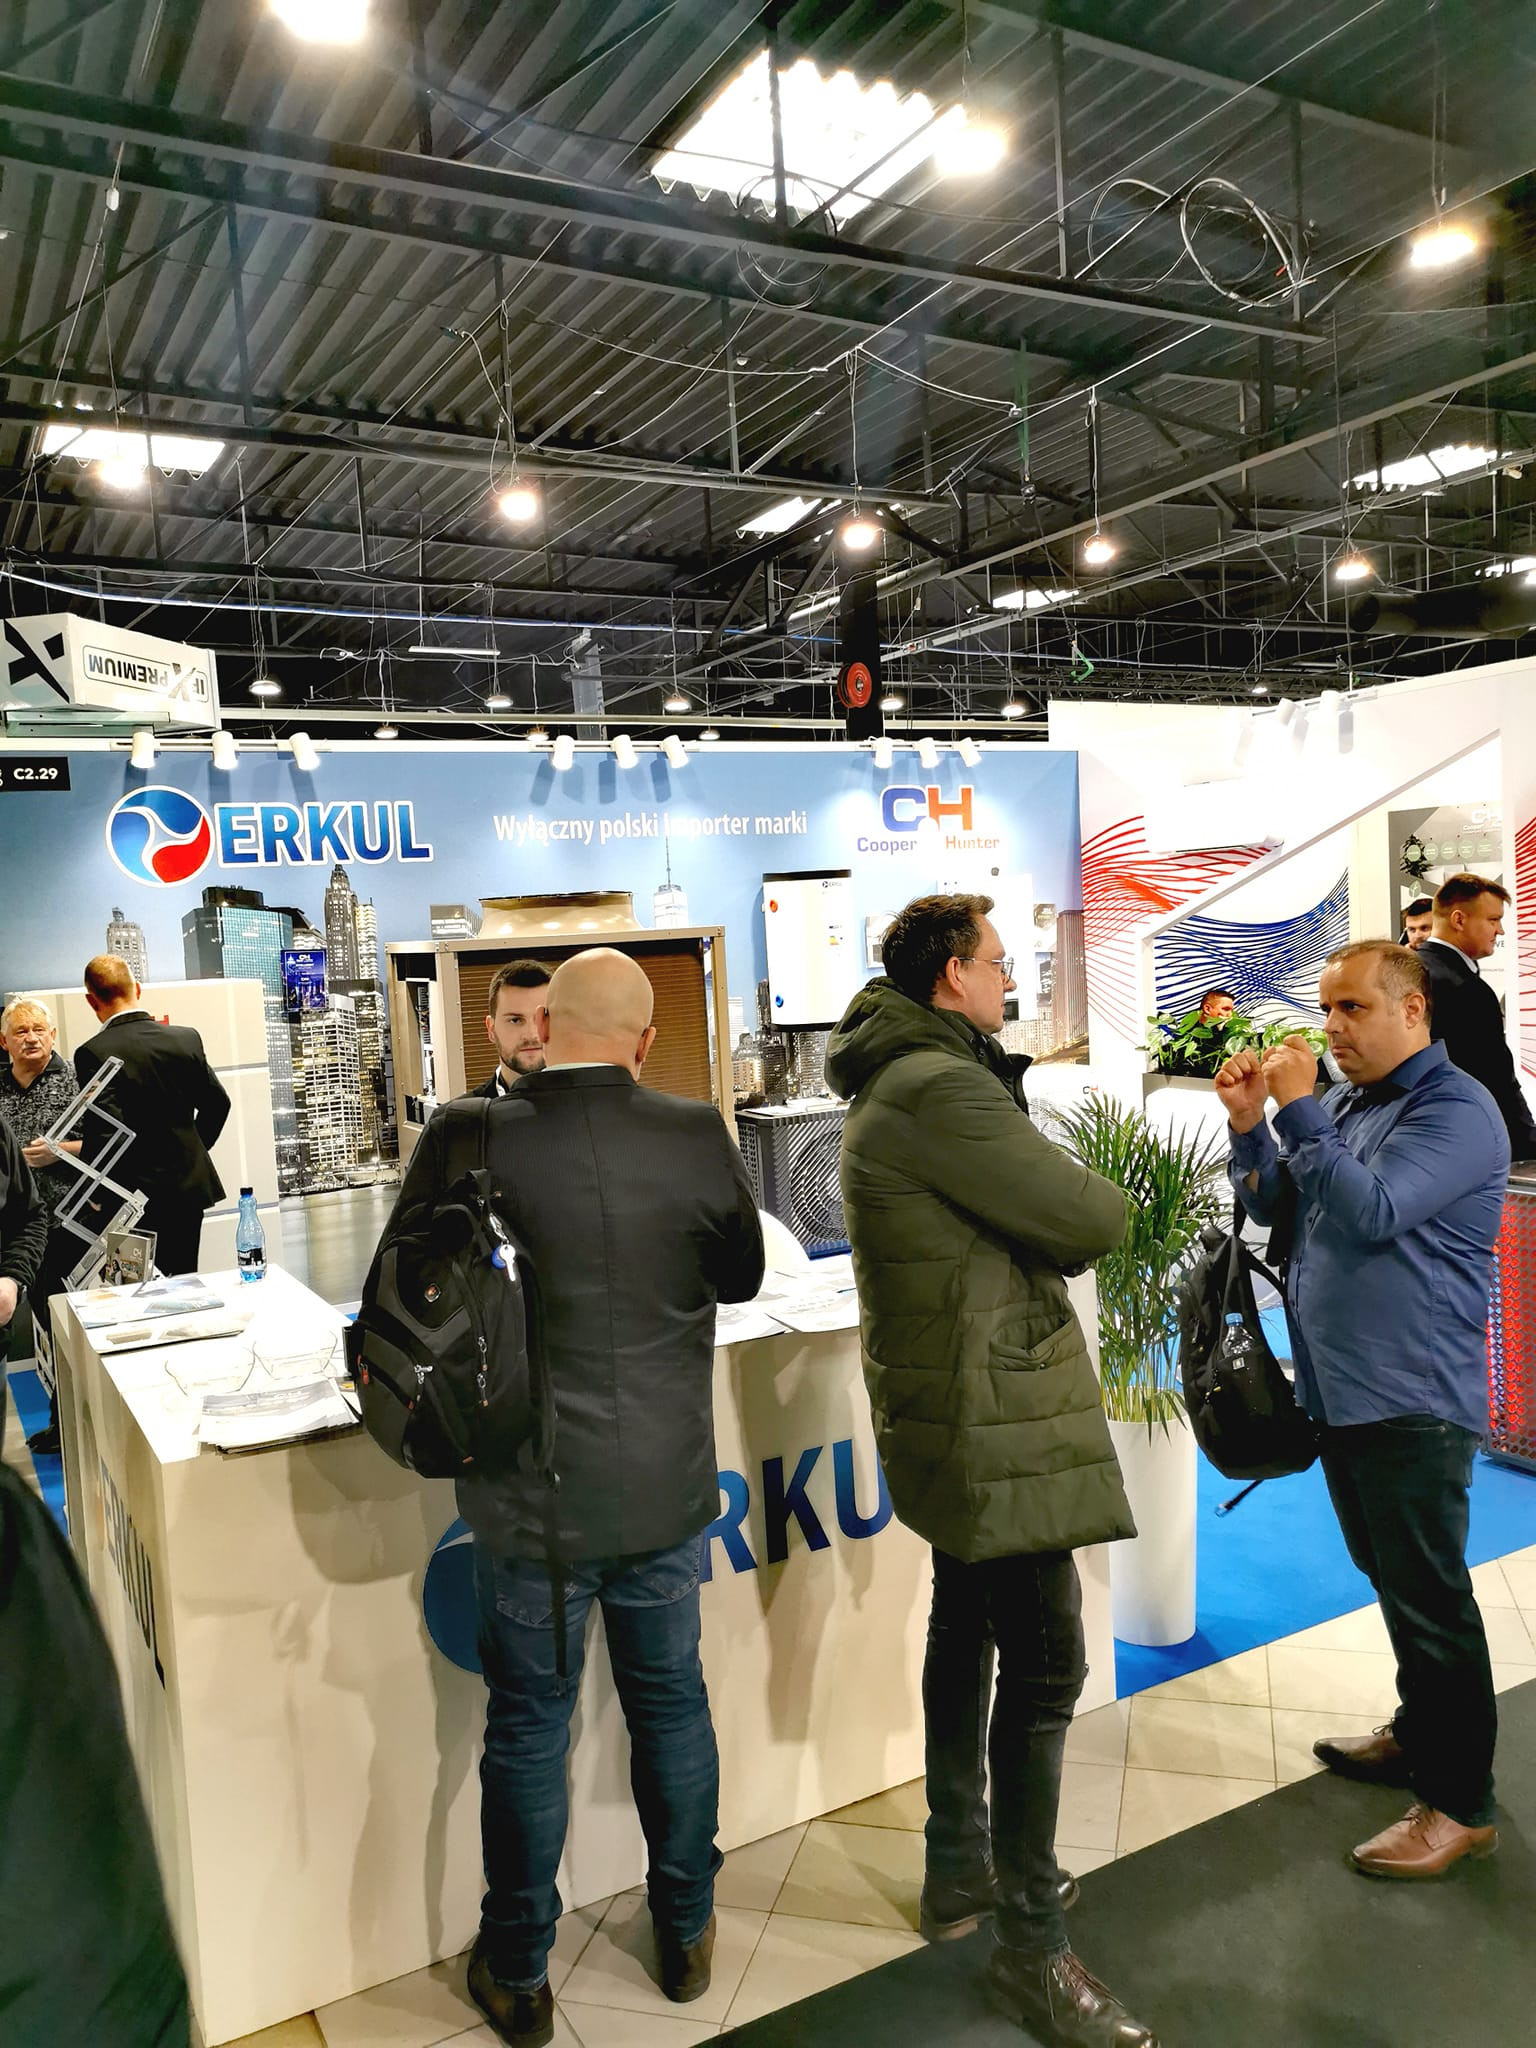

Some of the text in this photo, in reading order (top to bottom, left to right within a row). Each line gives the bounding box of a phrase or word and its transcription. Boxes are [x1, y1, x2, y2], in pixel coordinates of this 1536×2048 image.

[88, 653, 169, 687] PREMIUM
[13, 767, 58, 780] C2.29
[881, 785, 974, 832] CH
[215, 801, 433, 867] ERKUL
[493, 814, 594, 847] Wyłączny
[599, 812, 659, 845] polski
[754, 810, 807, 835] marki
[857, 836, 1000, 856] Cooper Hunter
[700, 1438, 894, 1585] RKU
